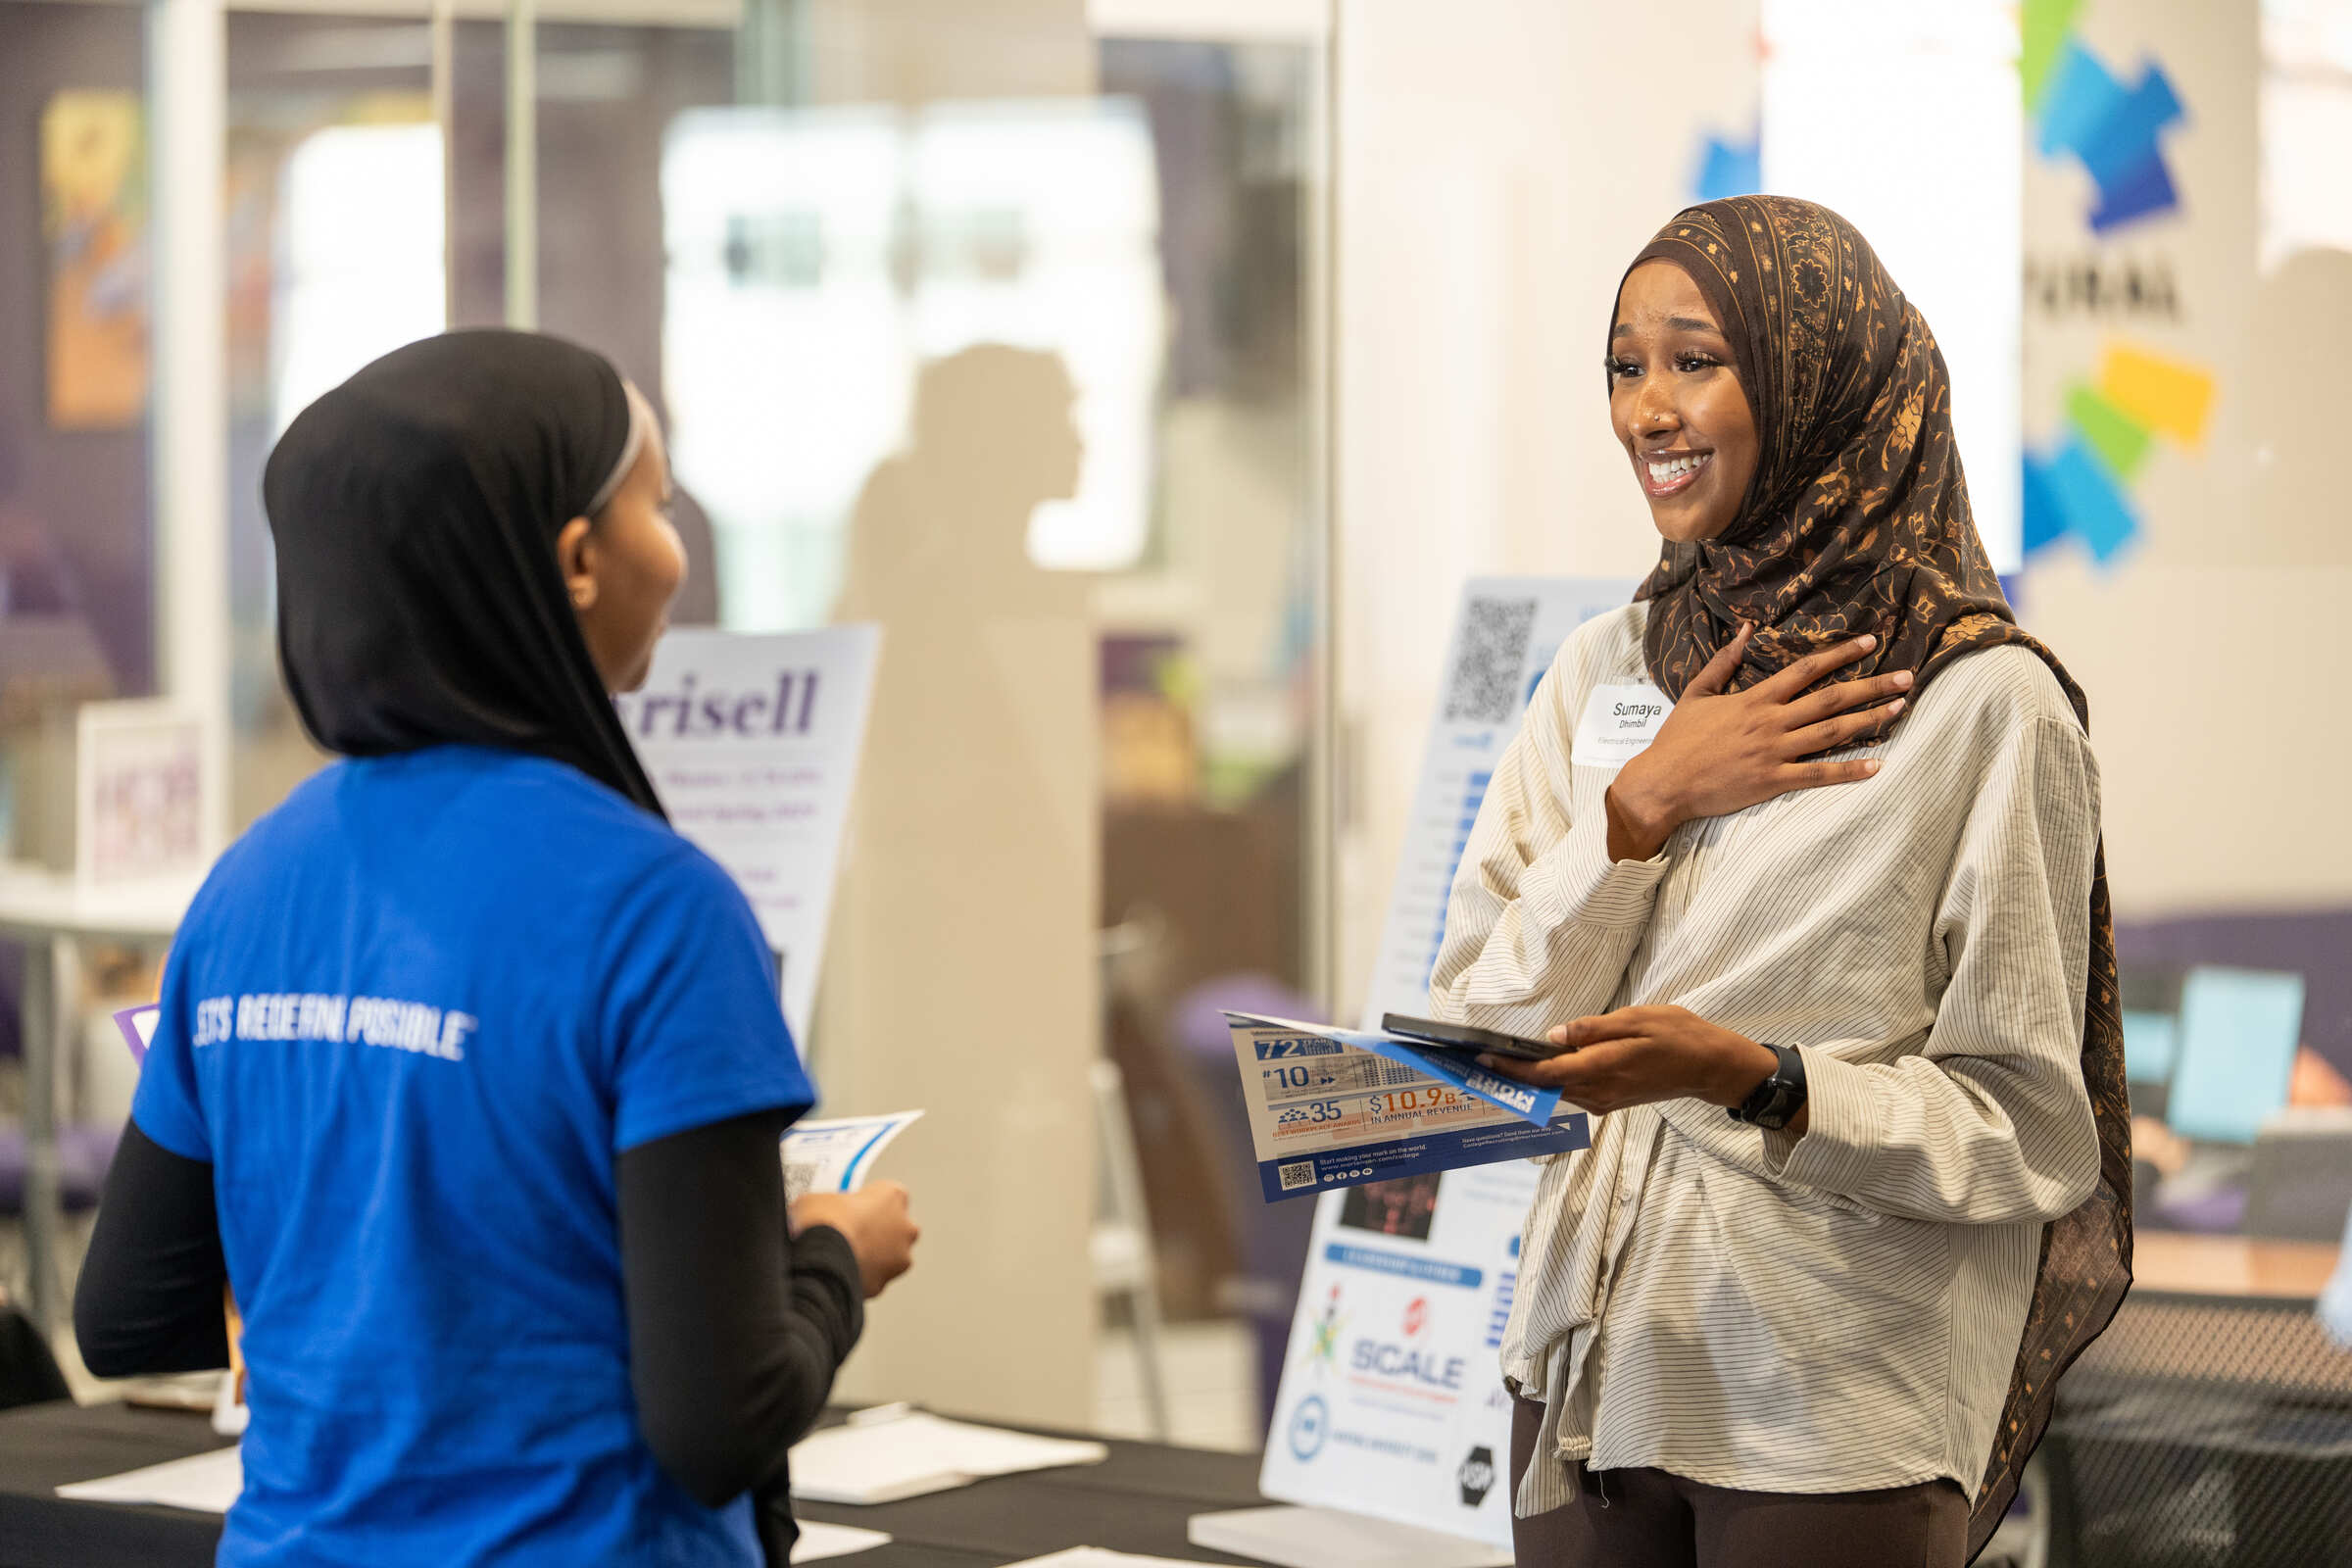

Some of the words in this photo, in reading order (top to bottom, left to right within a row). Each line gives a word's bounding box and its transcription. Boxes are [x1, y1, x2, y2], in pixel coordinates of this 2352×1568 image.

[1613, 703, 1662, 717] Sumaya
[1619, 719, 1646, 728] Dhimbil
[1257, 1040, 1300, 1059] 72
[1310, 1100, 1342, 1122] 35
[1371, 1116, 1382, 1125] IN
[1383, 1111, 1423, 1123] ANNUAL
[1426, 1103, 1473, 1117] REVENUE
[1336, 1154, 1358, 1164] making
[1351, 1339, 1465, 1389] SCALE
